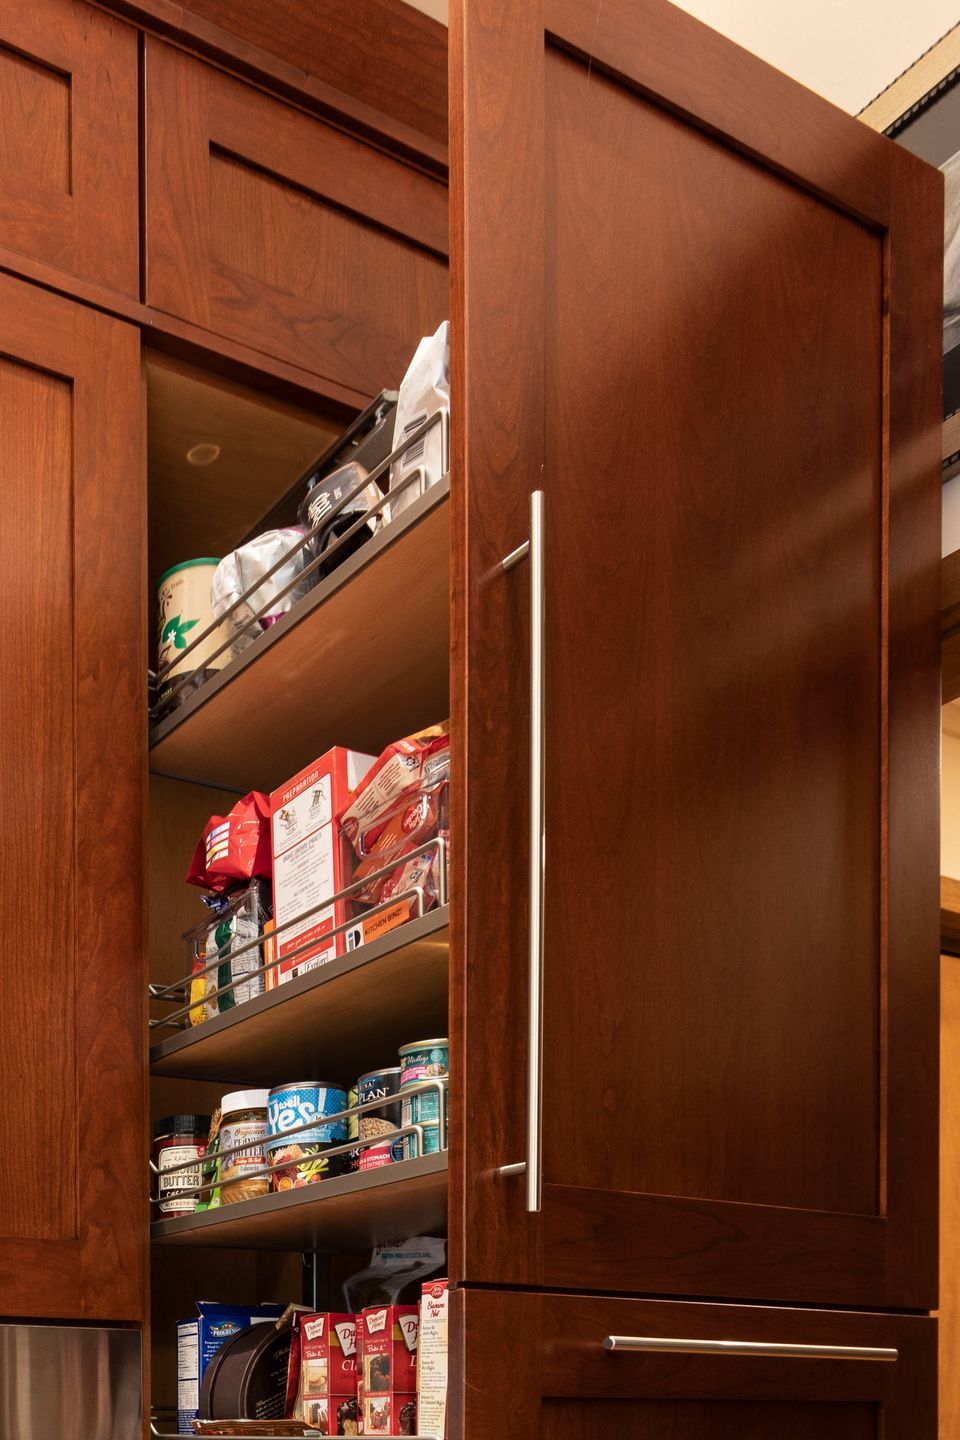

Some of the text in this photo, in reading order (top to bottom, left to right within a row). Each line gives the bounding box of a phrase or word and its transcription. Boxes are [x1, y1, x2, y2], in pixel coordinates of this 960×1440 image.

[282, 770, 319, 803] PREPARATION
[364, 918, 387, 936] KITCHEN
[279, 1095, 300, 1109] well
[367, 1153, 391, 1163] STOMACH
[163, 1174, 200, 1188] BUTTER
[430, 1309, 441, 1318] Nut
